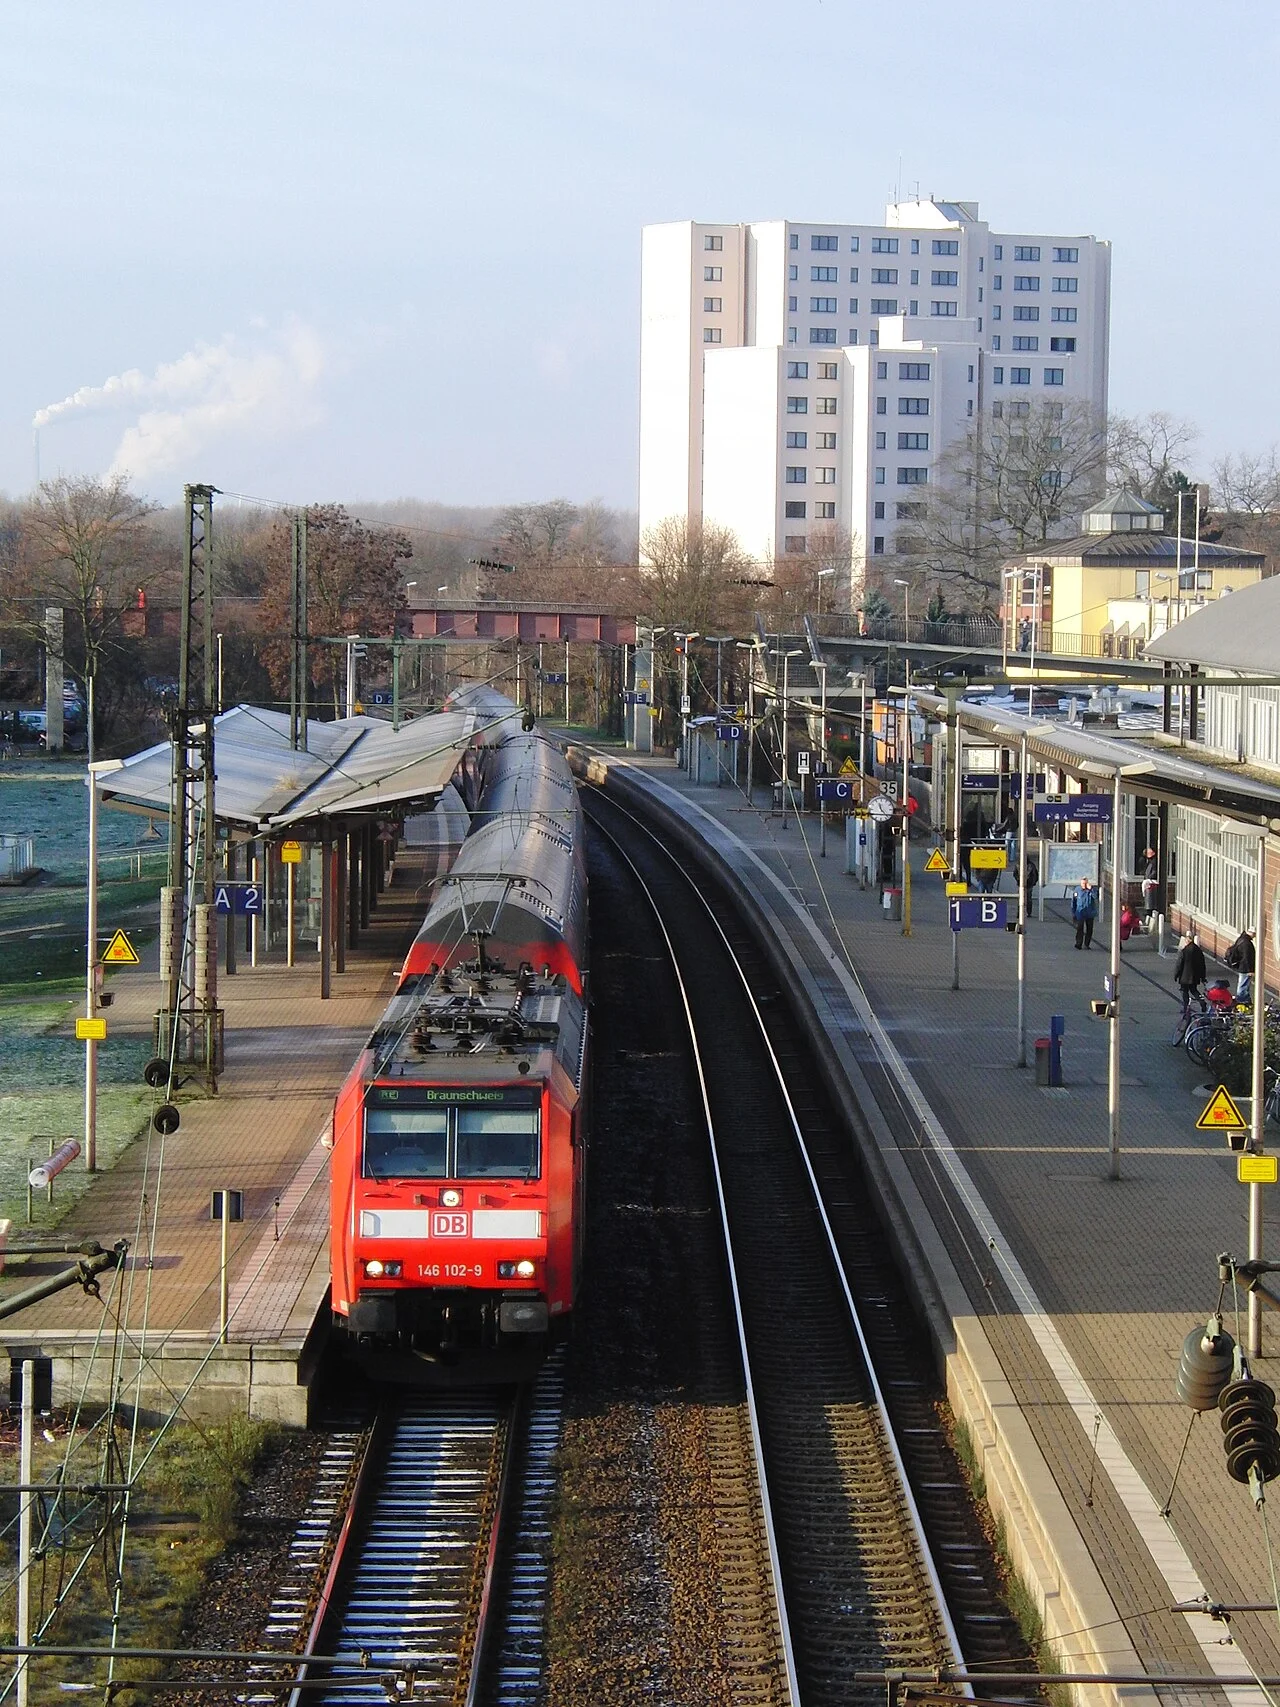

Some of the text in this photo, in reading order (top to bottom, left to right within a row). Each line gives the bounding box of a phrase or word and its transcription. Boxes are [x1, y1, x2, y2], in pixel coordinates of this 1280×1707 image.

[375, 694, 393, 704] D 2
[716, 726, 740, 738] 1 D
[799, 752, 808, 766] H
[816, 782, 848, 797] 1 C
[880, 782, 896, 795] 35
[215, 888, 258, 909] A 2
[951, 901, 998, 923] 1 B
[427, 1090, 504, 1100] Braunschweig
[436, 1215, 465, 1234] DB
[418, 1264, 482, 1277] 146 102-9
